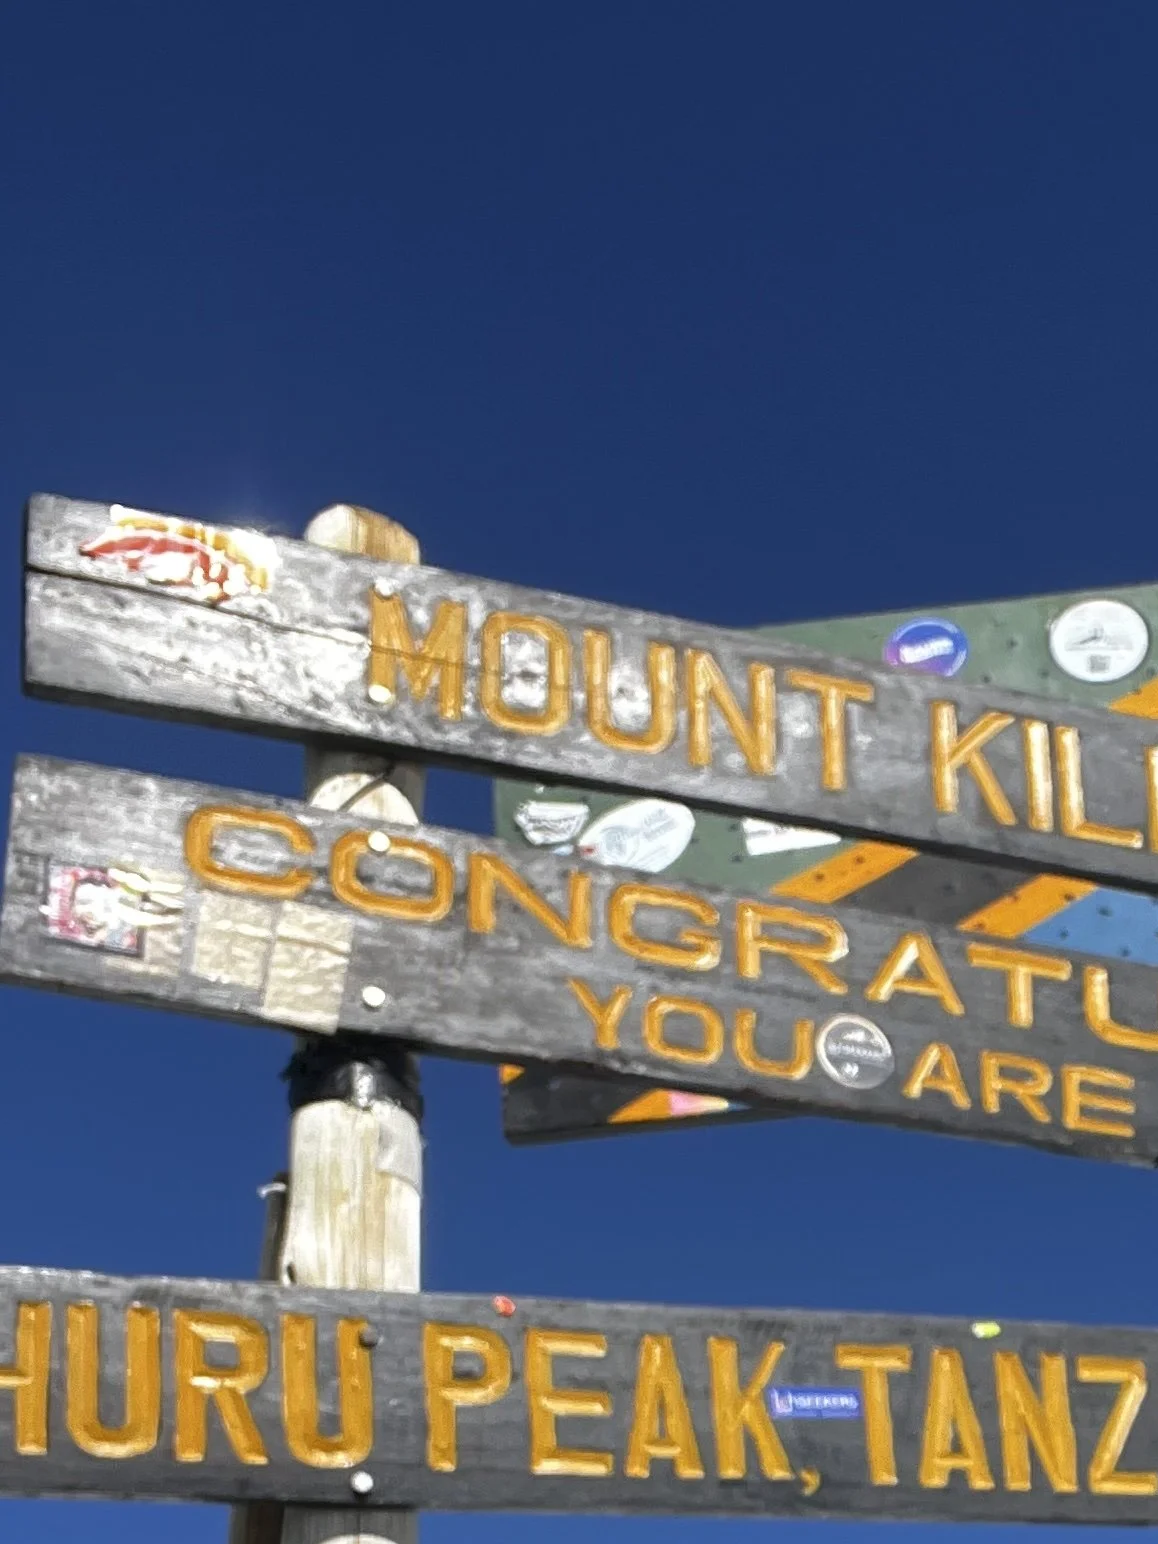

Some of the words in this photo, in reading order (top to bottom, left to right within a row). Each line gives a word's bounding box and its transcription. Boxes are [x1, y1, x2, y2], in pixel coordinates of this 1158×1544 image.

[366, 586, 875, 794] MOUNT
[567, 977, 818, 1080] YOU
[901, 1041, 1136, 1140] ARE
